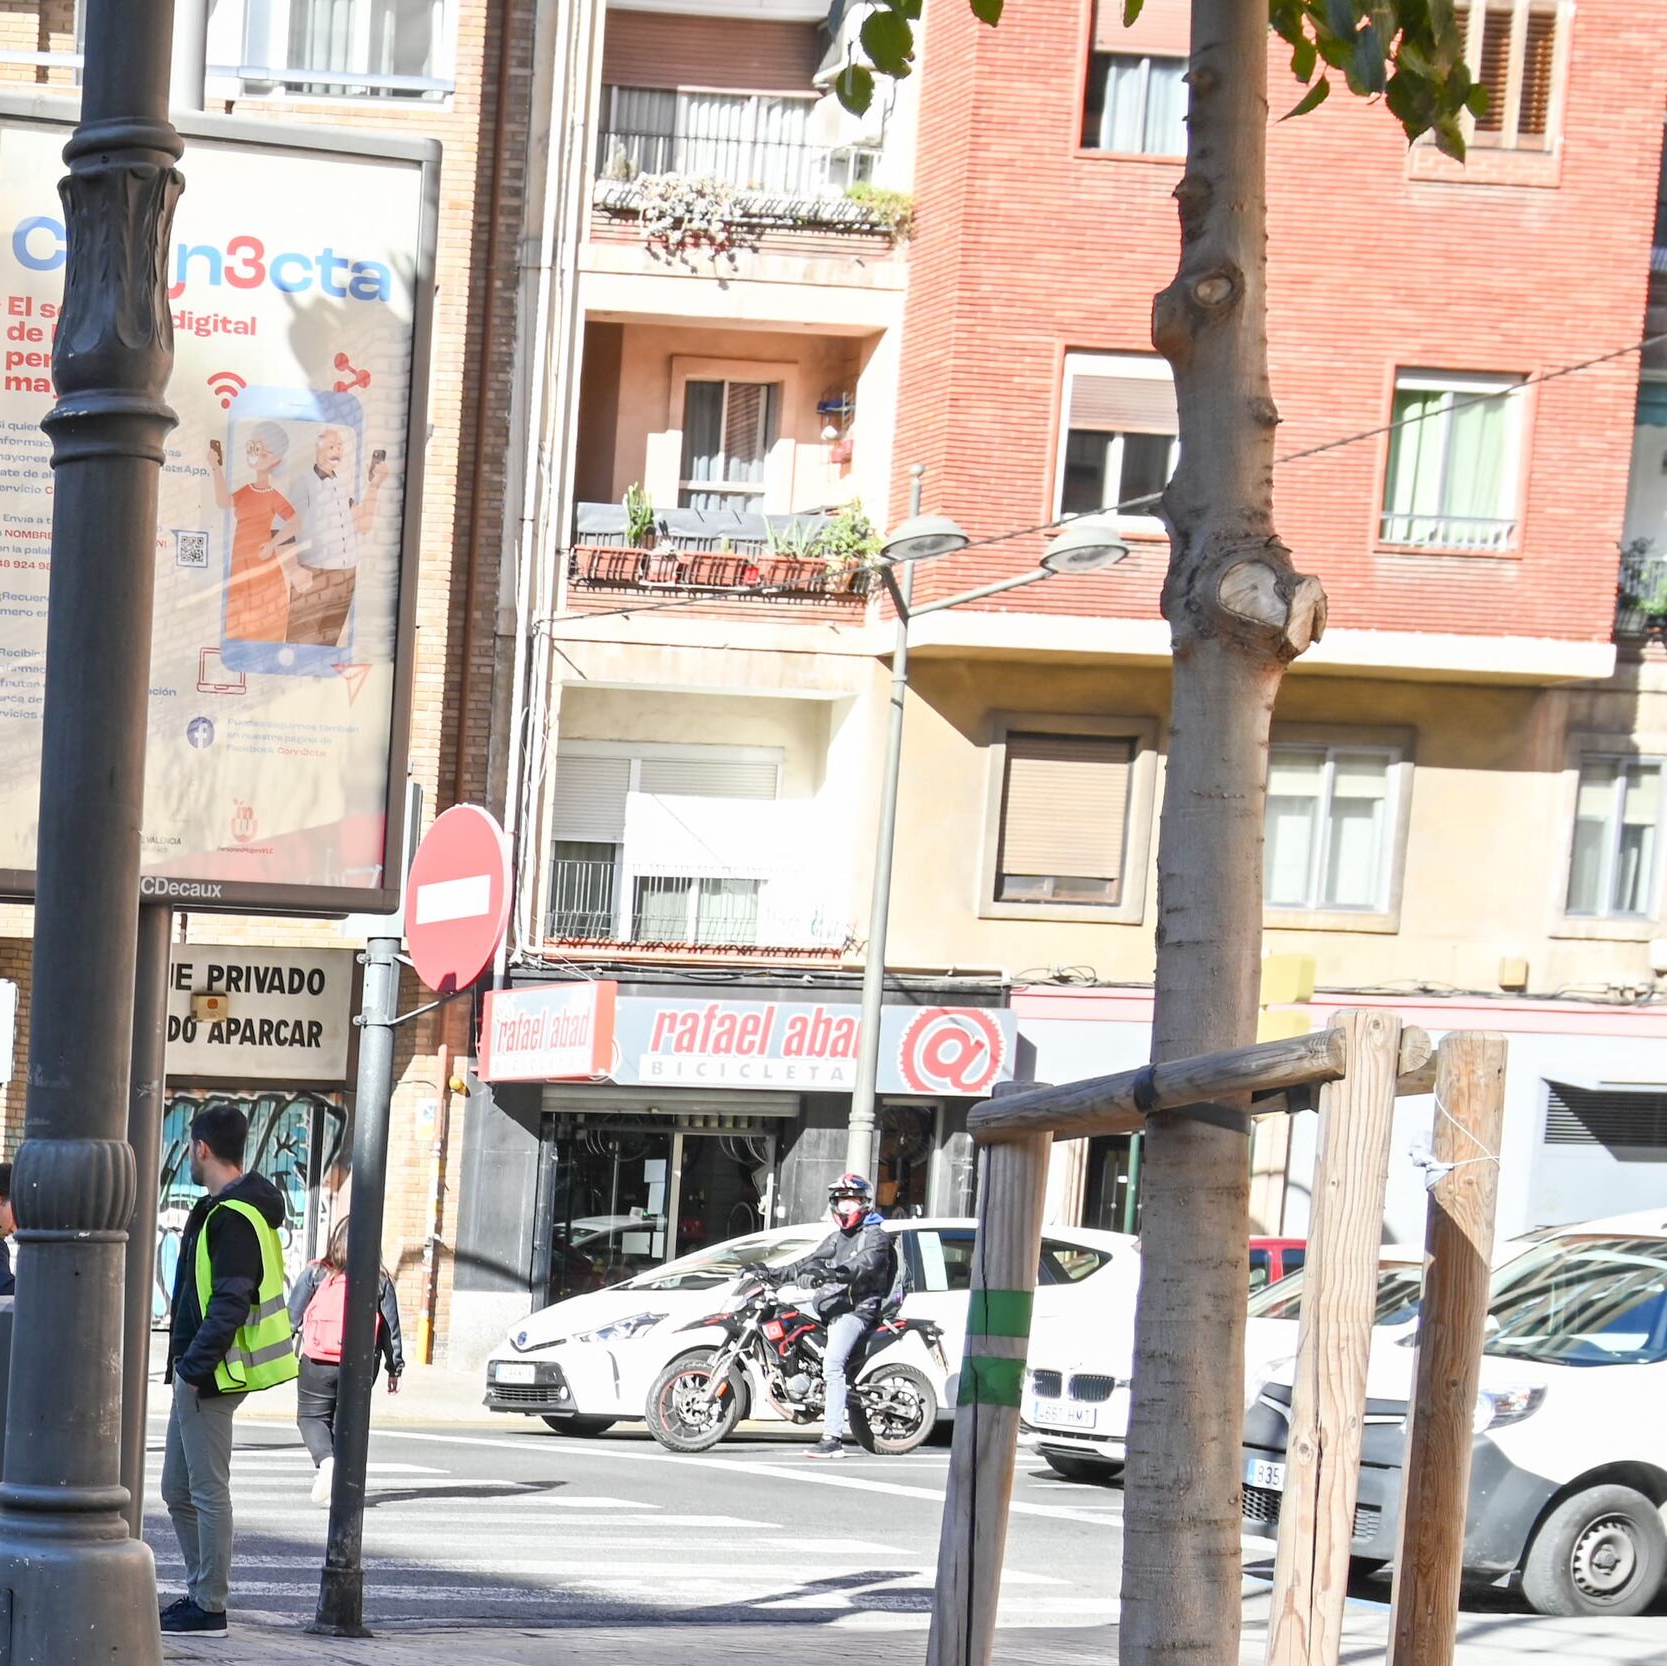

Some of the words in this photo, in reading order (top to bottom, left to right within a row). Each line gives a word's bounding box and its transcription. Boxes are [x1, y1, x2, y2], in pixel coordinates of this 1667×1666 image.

[12, 215, 392, 302] Cn3cta
[7, 321, 43, 342] de
[8, 296, 32, 316] El
[170, 311, 257, 337] digital
[23, 469, 38, 478] de
[12, 545, 22, 553] la
[13, 560, 35, 569] 924
[206, 964, 326, 996] PRIVADO
[207, 1017, 324, 1048] APARCAR
[496, 1009, 548, 1053] rafael
[550, 1007, 591, 1050] abad
[650, 1004, 776, 1055] rafael
[650, 1060, 845, 1081] BICICLETA
